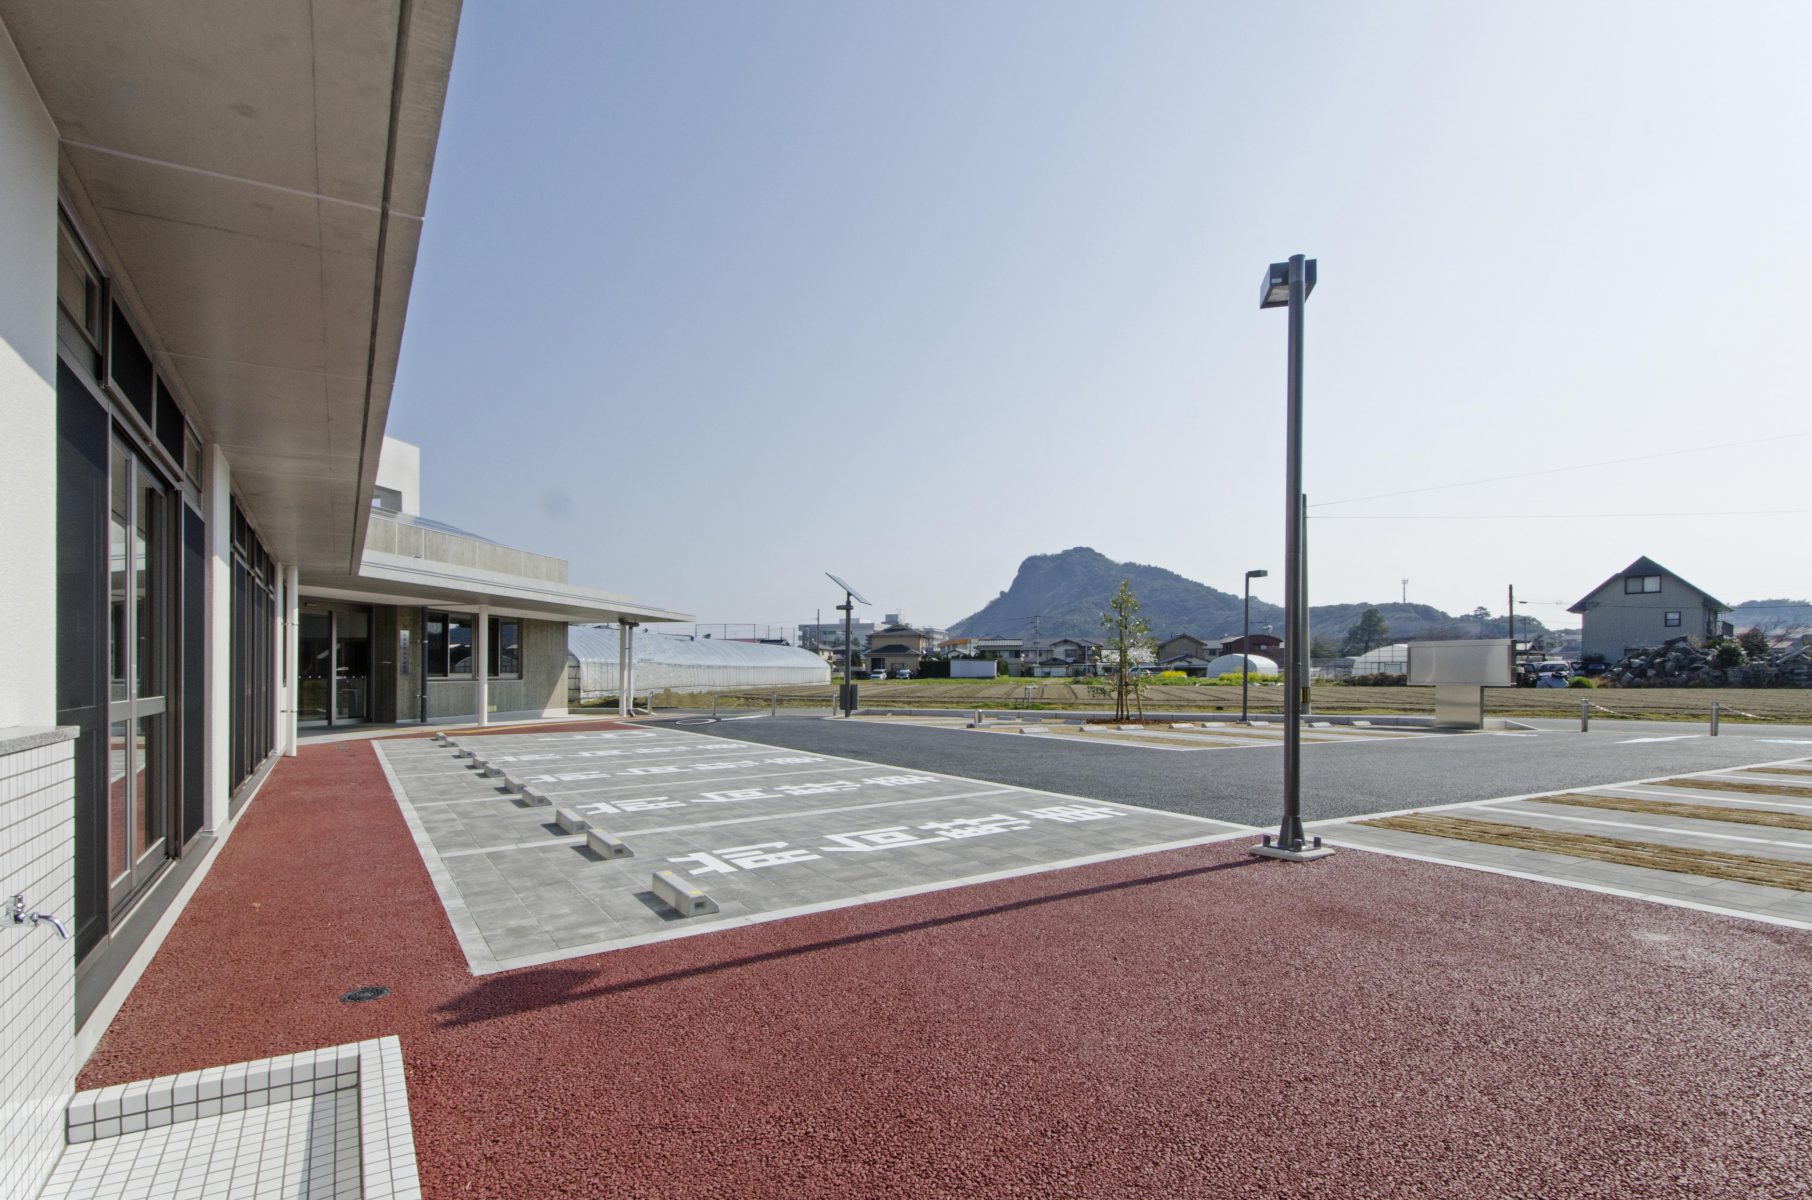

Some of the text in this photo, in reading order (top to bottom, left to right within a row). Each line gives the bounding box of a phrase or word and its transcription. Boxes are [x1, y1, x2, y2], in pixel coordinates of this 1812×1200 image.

[577, 775, 939, 815] 前向駐車
[668, 806, 1127, 875] 前向駐車
